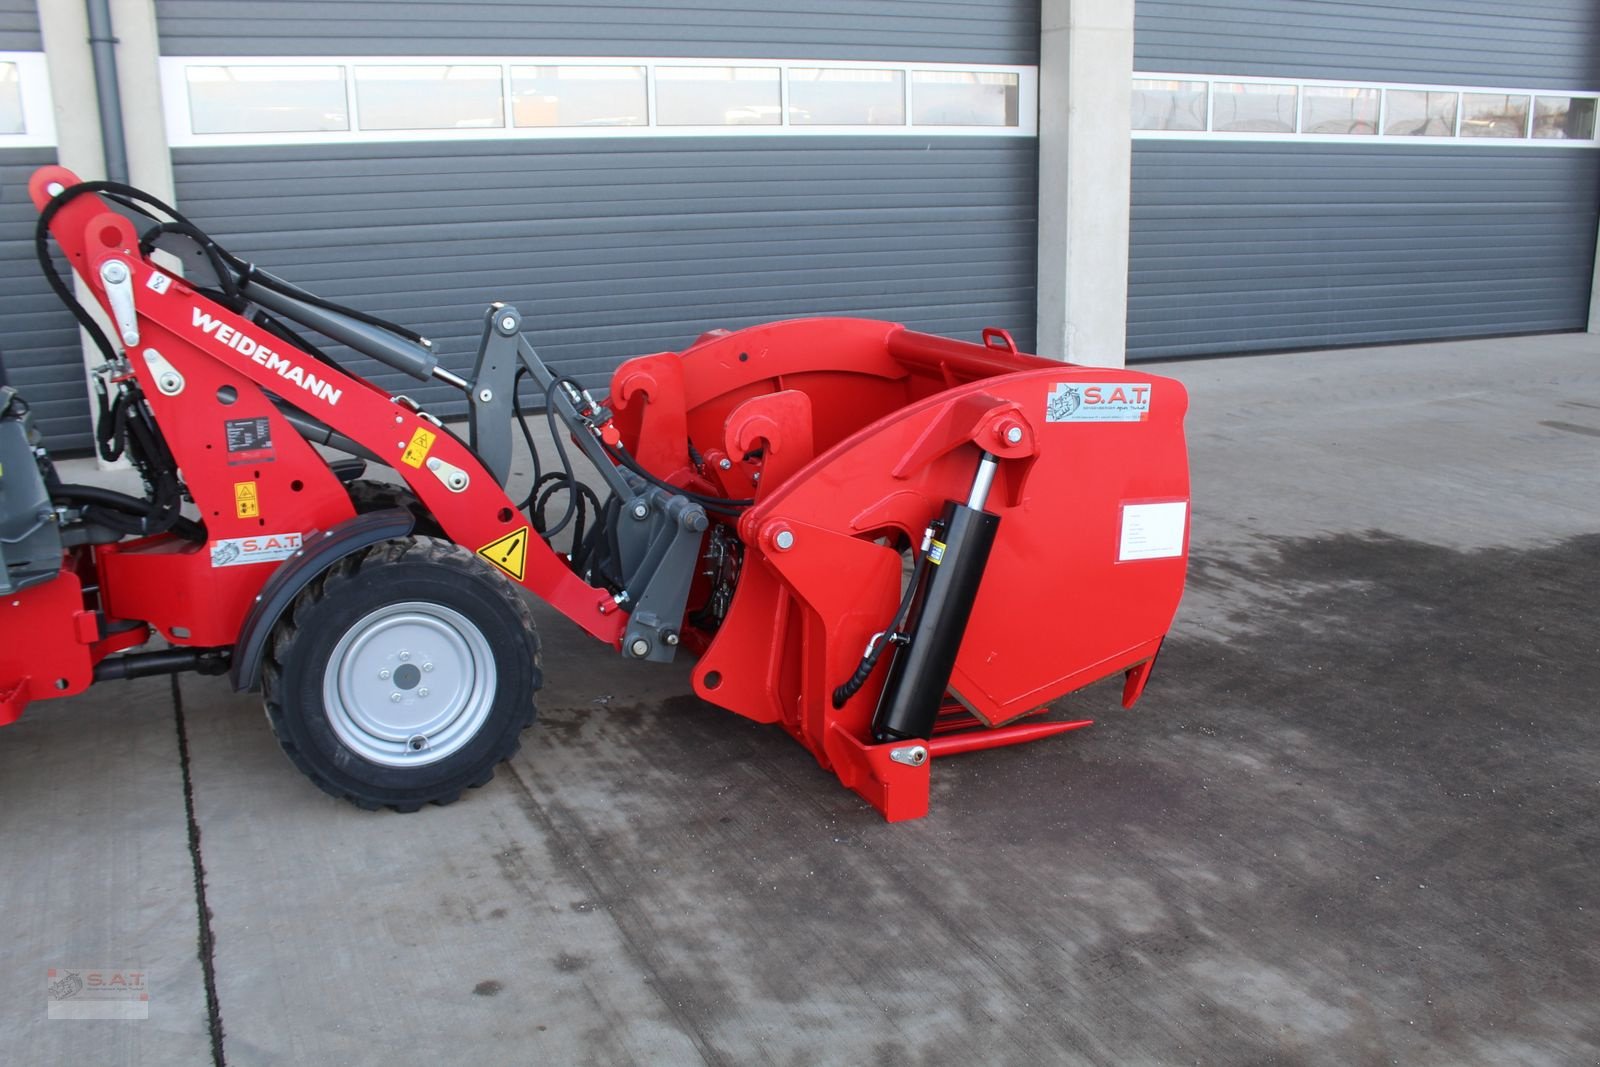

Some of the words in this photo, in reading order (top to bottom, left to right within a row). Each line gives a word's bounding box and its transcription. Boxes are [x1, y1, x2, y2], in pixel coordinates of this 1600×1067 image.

[192, 306, 343, 406] WEIDEMANN
[1084, 386, 1148, 405] S.A.T.
[242, 535, 300, 552] S.A.T.
